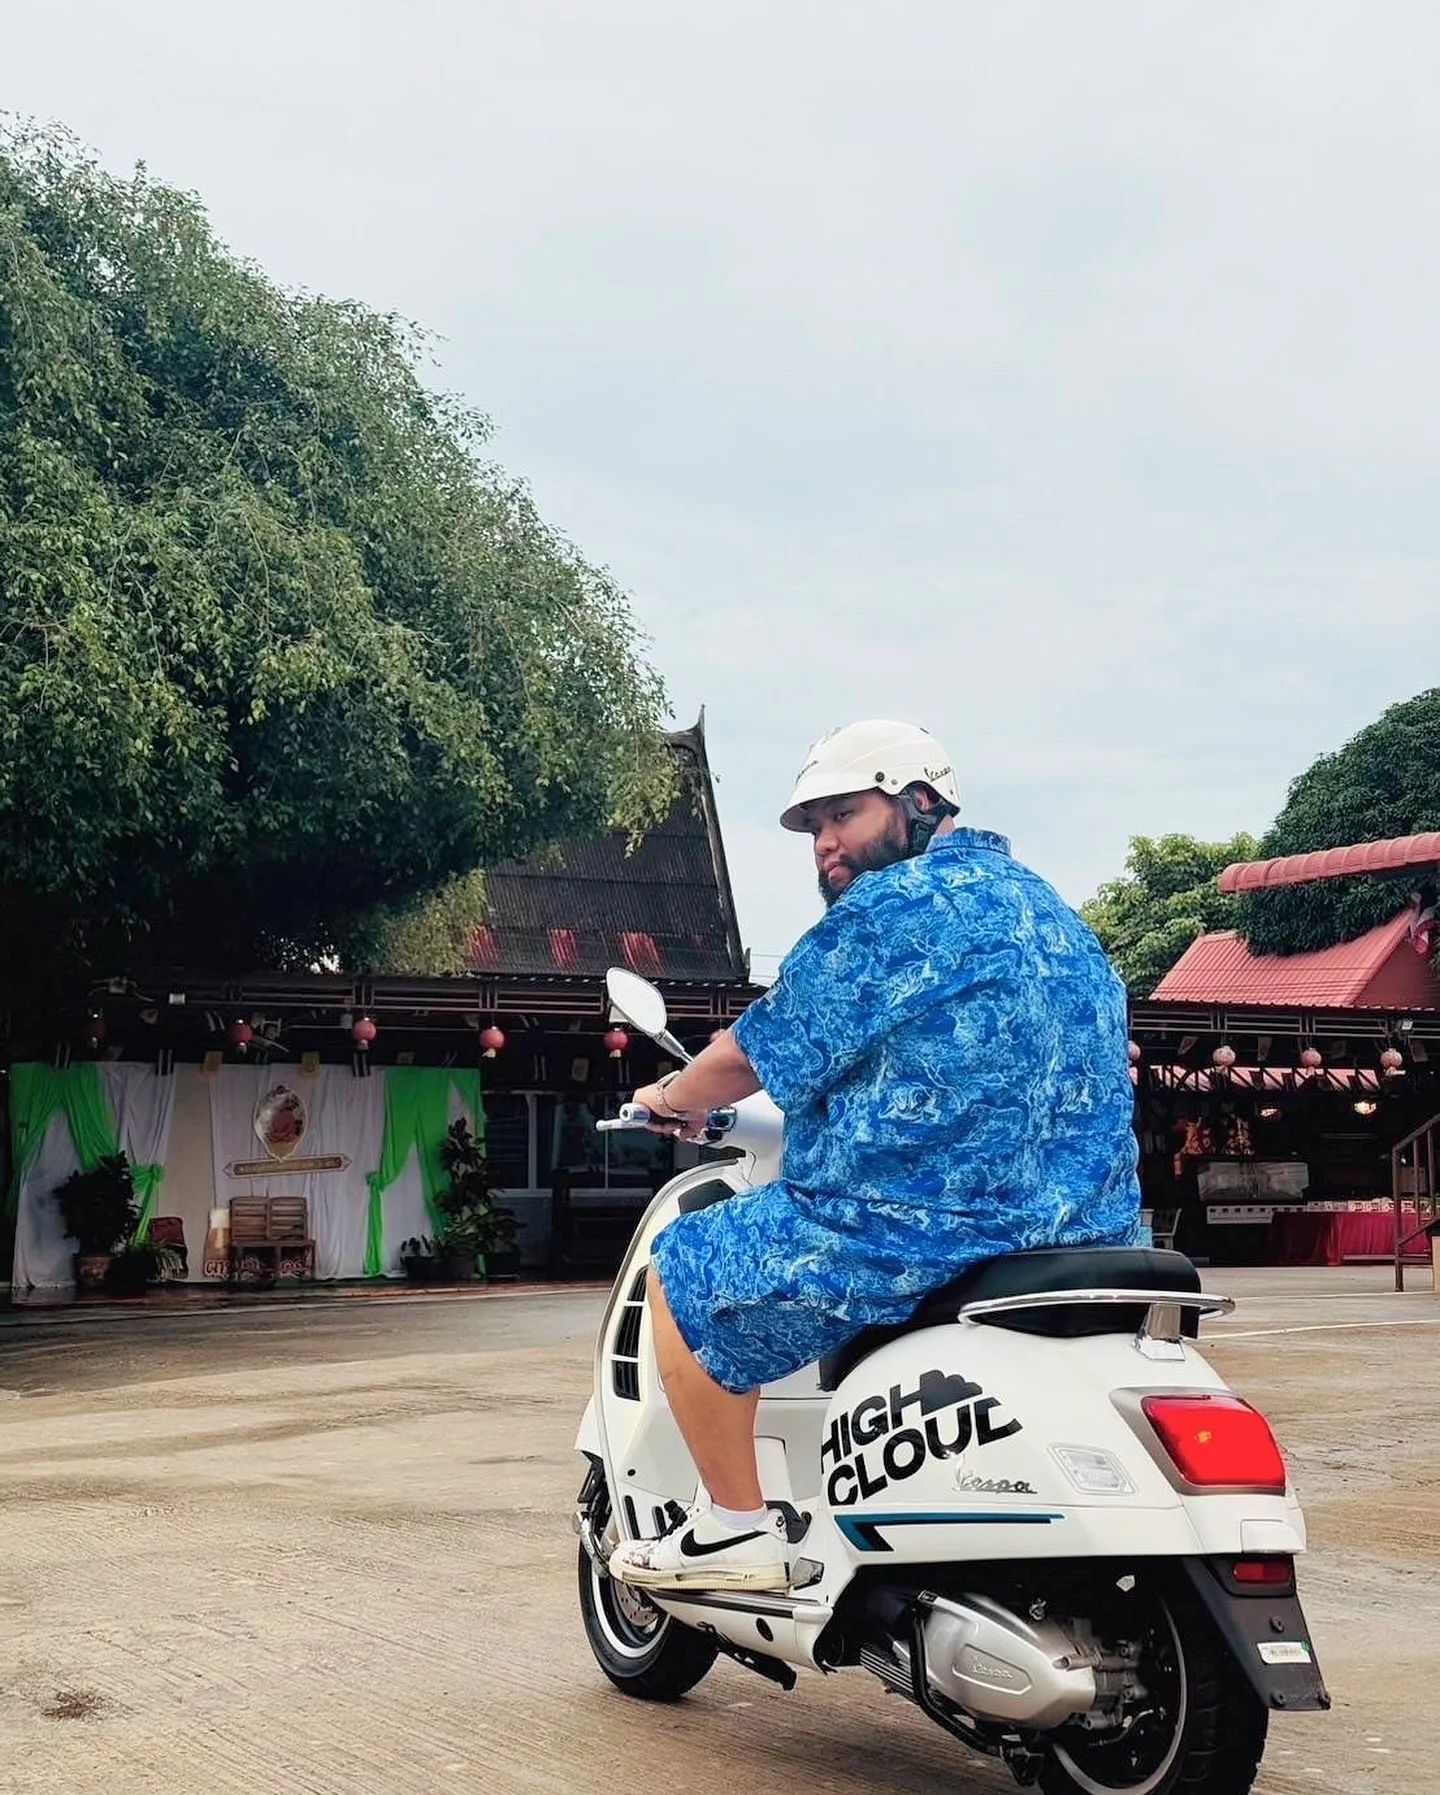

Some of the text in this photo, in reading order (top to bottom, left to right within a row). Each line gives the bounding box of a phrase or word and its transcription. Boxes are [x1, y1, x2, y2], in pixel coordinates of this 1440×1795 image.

[821, 1370, 952, 1475] HIGH
[827, 1396, 1023, 1507] CLOUD
[953, 1454, 1038, 1494] Vespa
